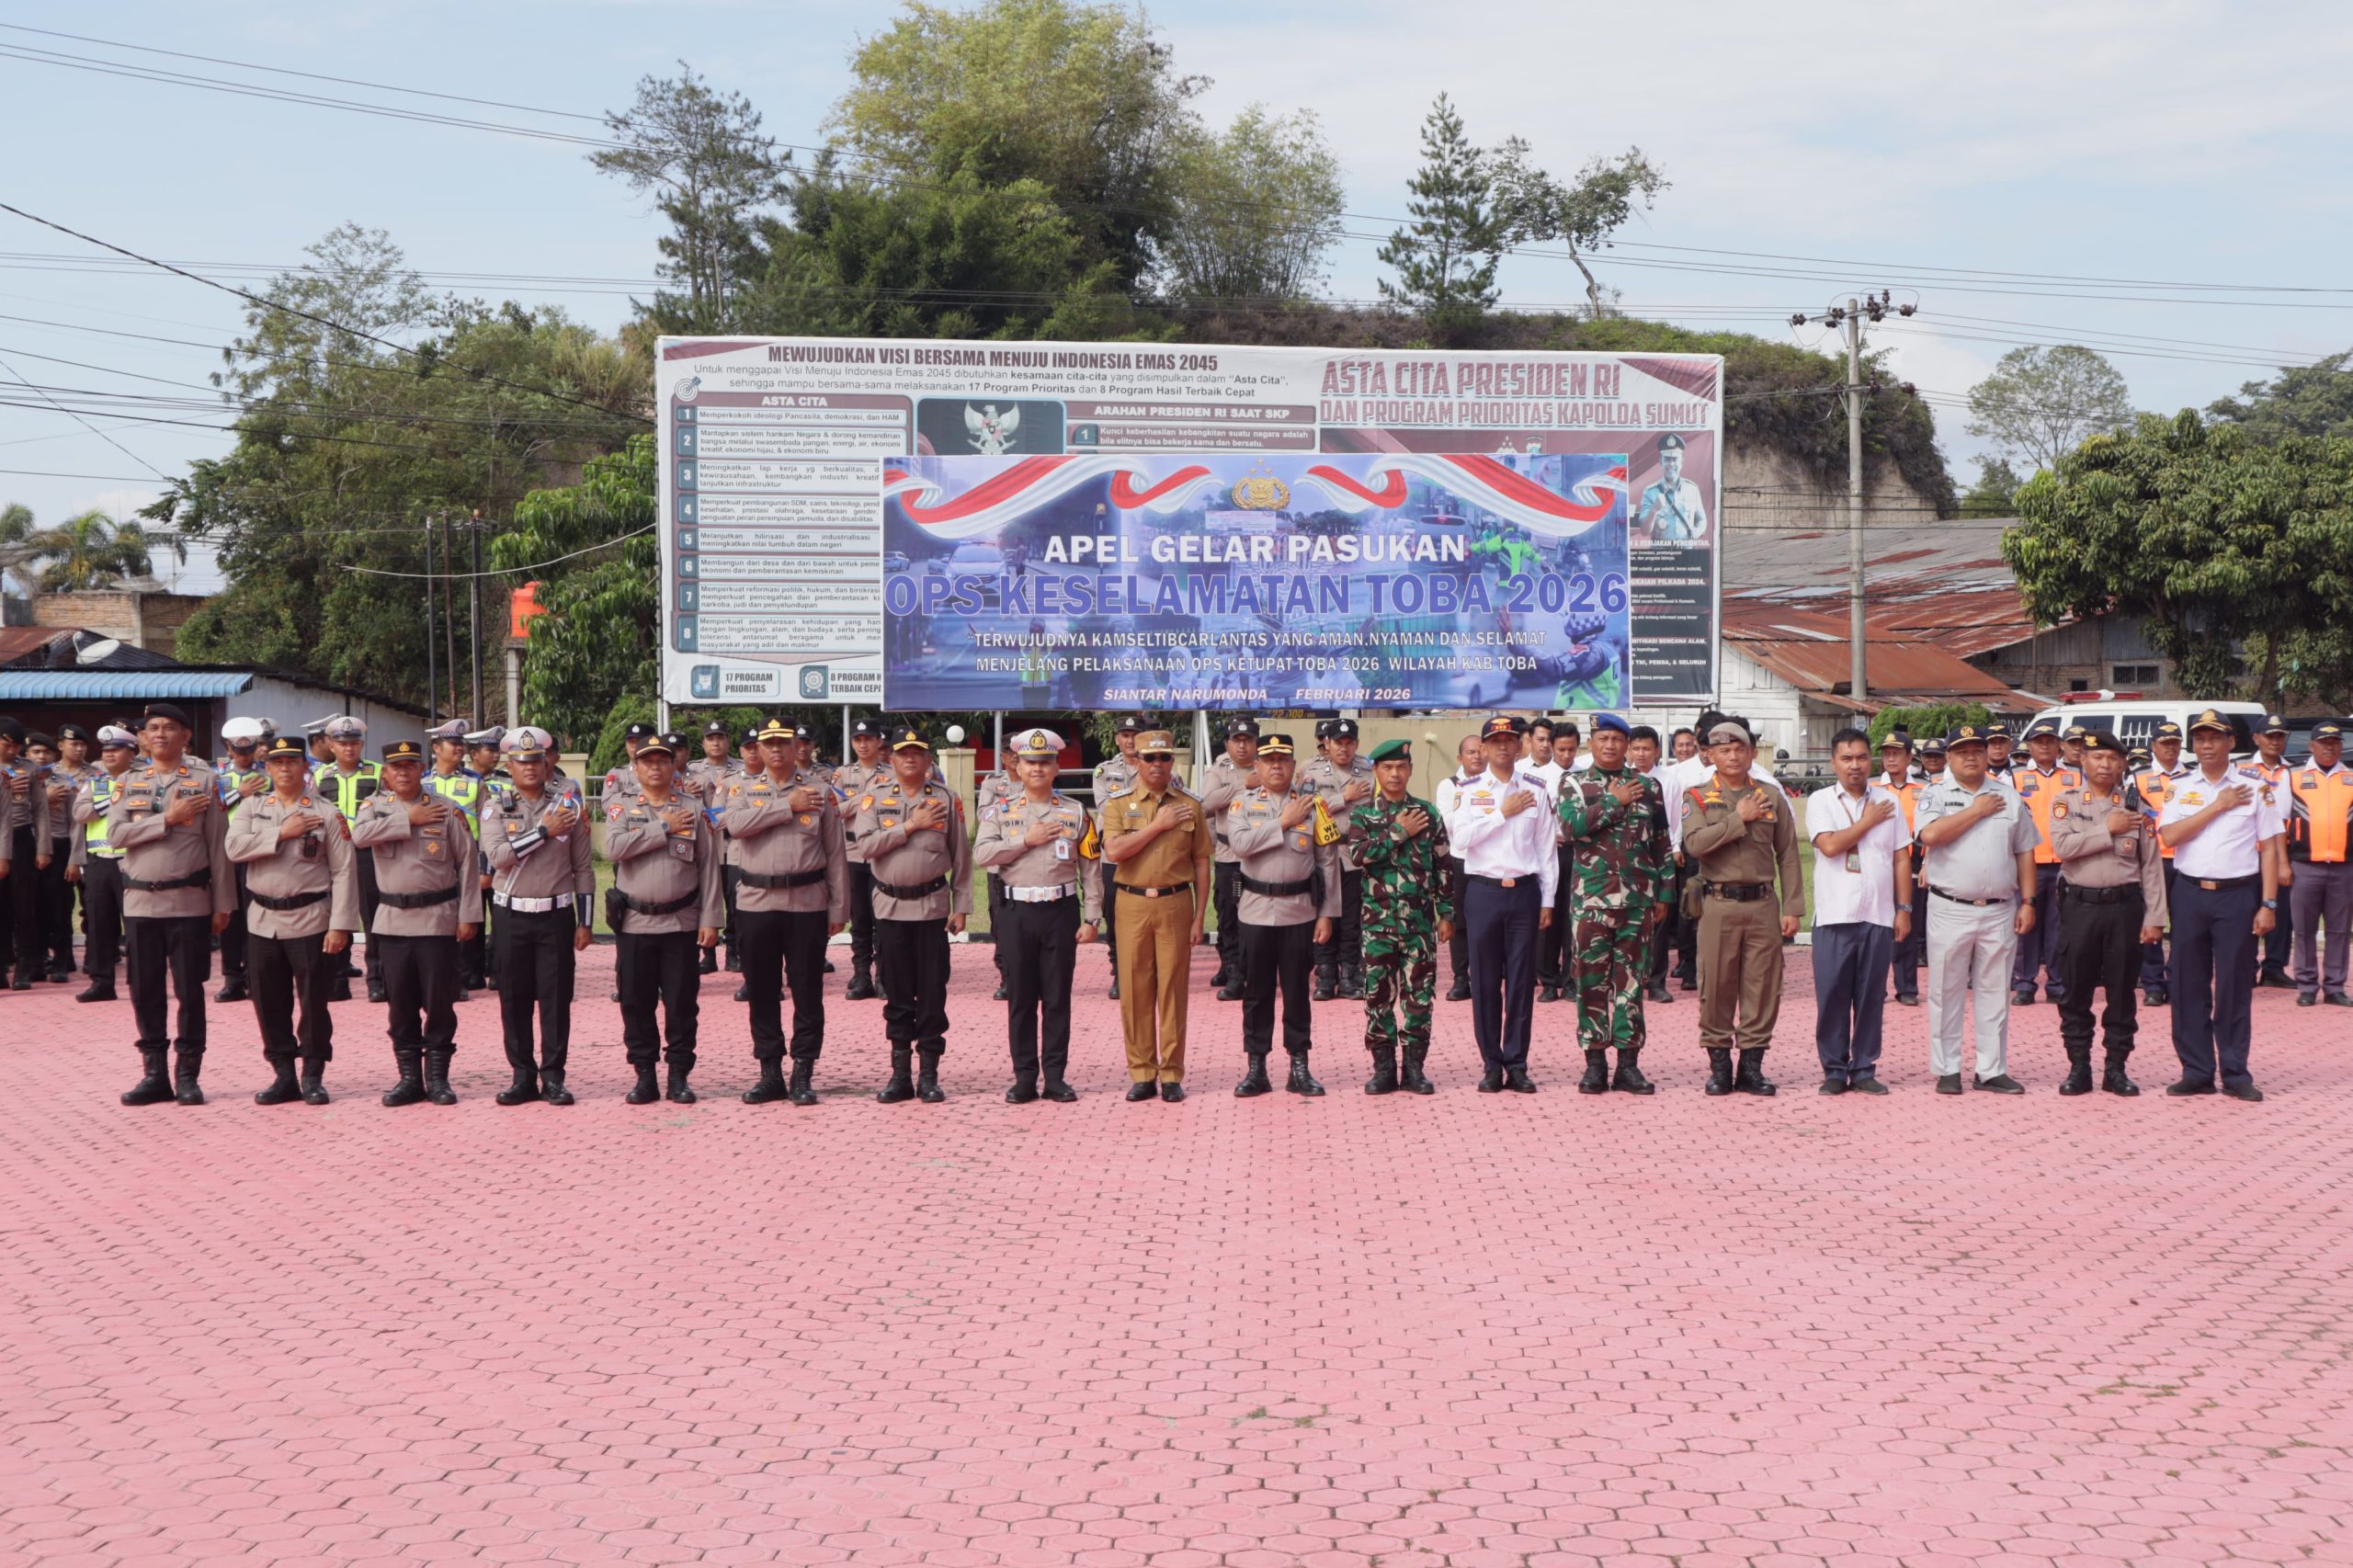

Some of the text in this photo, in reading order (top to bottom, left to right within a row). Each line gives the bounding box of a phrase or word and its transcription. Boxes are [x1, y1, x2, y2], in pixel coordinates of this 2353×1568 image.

[767, 347, 1217, 370] MEWUJUDKAN VISI BERSAMA MENUJU INDONESIA EMAS 2045
[694, 365, 723, 374] Untuk
[725, 365, 781, 378] menggapai
[784, 366, 802, 375] Visi
[805, 367, 842, 379] Menuju
[844, 368, 892, 377] Indonesia
[895, 369, 924, 378] Emas
[926, 369, 951, 379] 2045
[953, 369, 1007, 380] dibutuhkan
[1009, 370, 1063, 381] kesamaan
[1065, 371, 1108, 381] cita-cita
[1109, 374, 1134, 384] yang
[1136, 373, 1194, 385] disimpulkan
[1196, 374, 1226, 383] dalam
[1321, 361, 1620, 396] ASTA CITA PRESIDEN RI
[730, 379, 1255, 399] sehingga mampu bersama-sama melaksanakan 17 Program Prioritas dan 8 Program Hasil Terbaik Cepat
[761, 397, 827, 406] ASTA CITA
[684, 409, 690, 419] 1
[699, 411, 752, 421] Memperkokoh
[753, 412, 783, 421] ideologi
[1094, 406, 1290, 419] ARAHAN PRESIDEN RI SAAT SKP
[1320, 400, 1709, 425] DAN PROGRAM PRIORITAS KAPOLDA SUMUT
[1081, 429, 1089, 439] 1
[1177, 429, 1226, 438] kebangkitan
[684, 435, 691, 446] 2
[684, 470, 691, 480] 3
[684, 505, 691, 515] 4
[684, 534, 691, 544] 5
[1043, 534, 1464, 562] APEL GELAR PASUKAN
[685, 562, 692, 572] 6
[686, 593, 692, 602] 7
[884, 573, 1627, 616] OPS KESELAMATAN TOBA 2026
[1092, 632, 1267, 647] KAMSELTIBCARLANTAS
[1273, 632, 1313, 646] YANG
[1439, 631, 1472, 646] DAN
[1475, 631, 1546, 645] SELAMAT
[976, 656, 1537, 672] MENJELANG PELAKSANAAN OPS KETUPAT TOBA 2026 WILAYAH KAB TOBA
[724, 685, 766, 693] PRIORITAS
[830, 685, 862, 693] TERBAIK
[1103, 688, 1411, 701] SIANTAR NARUMONDA FEBRUARI 2026
